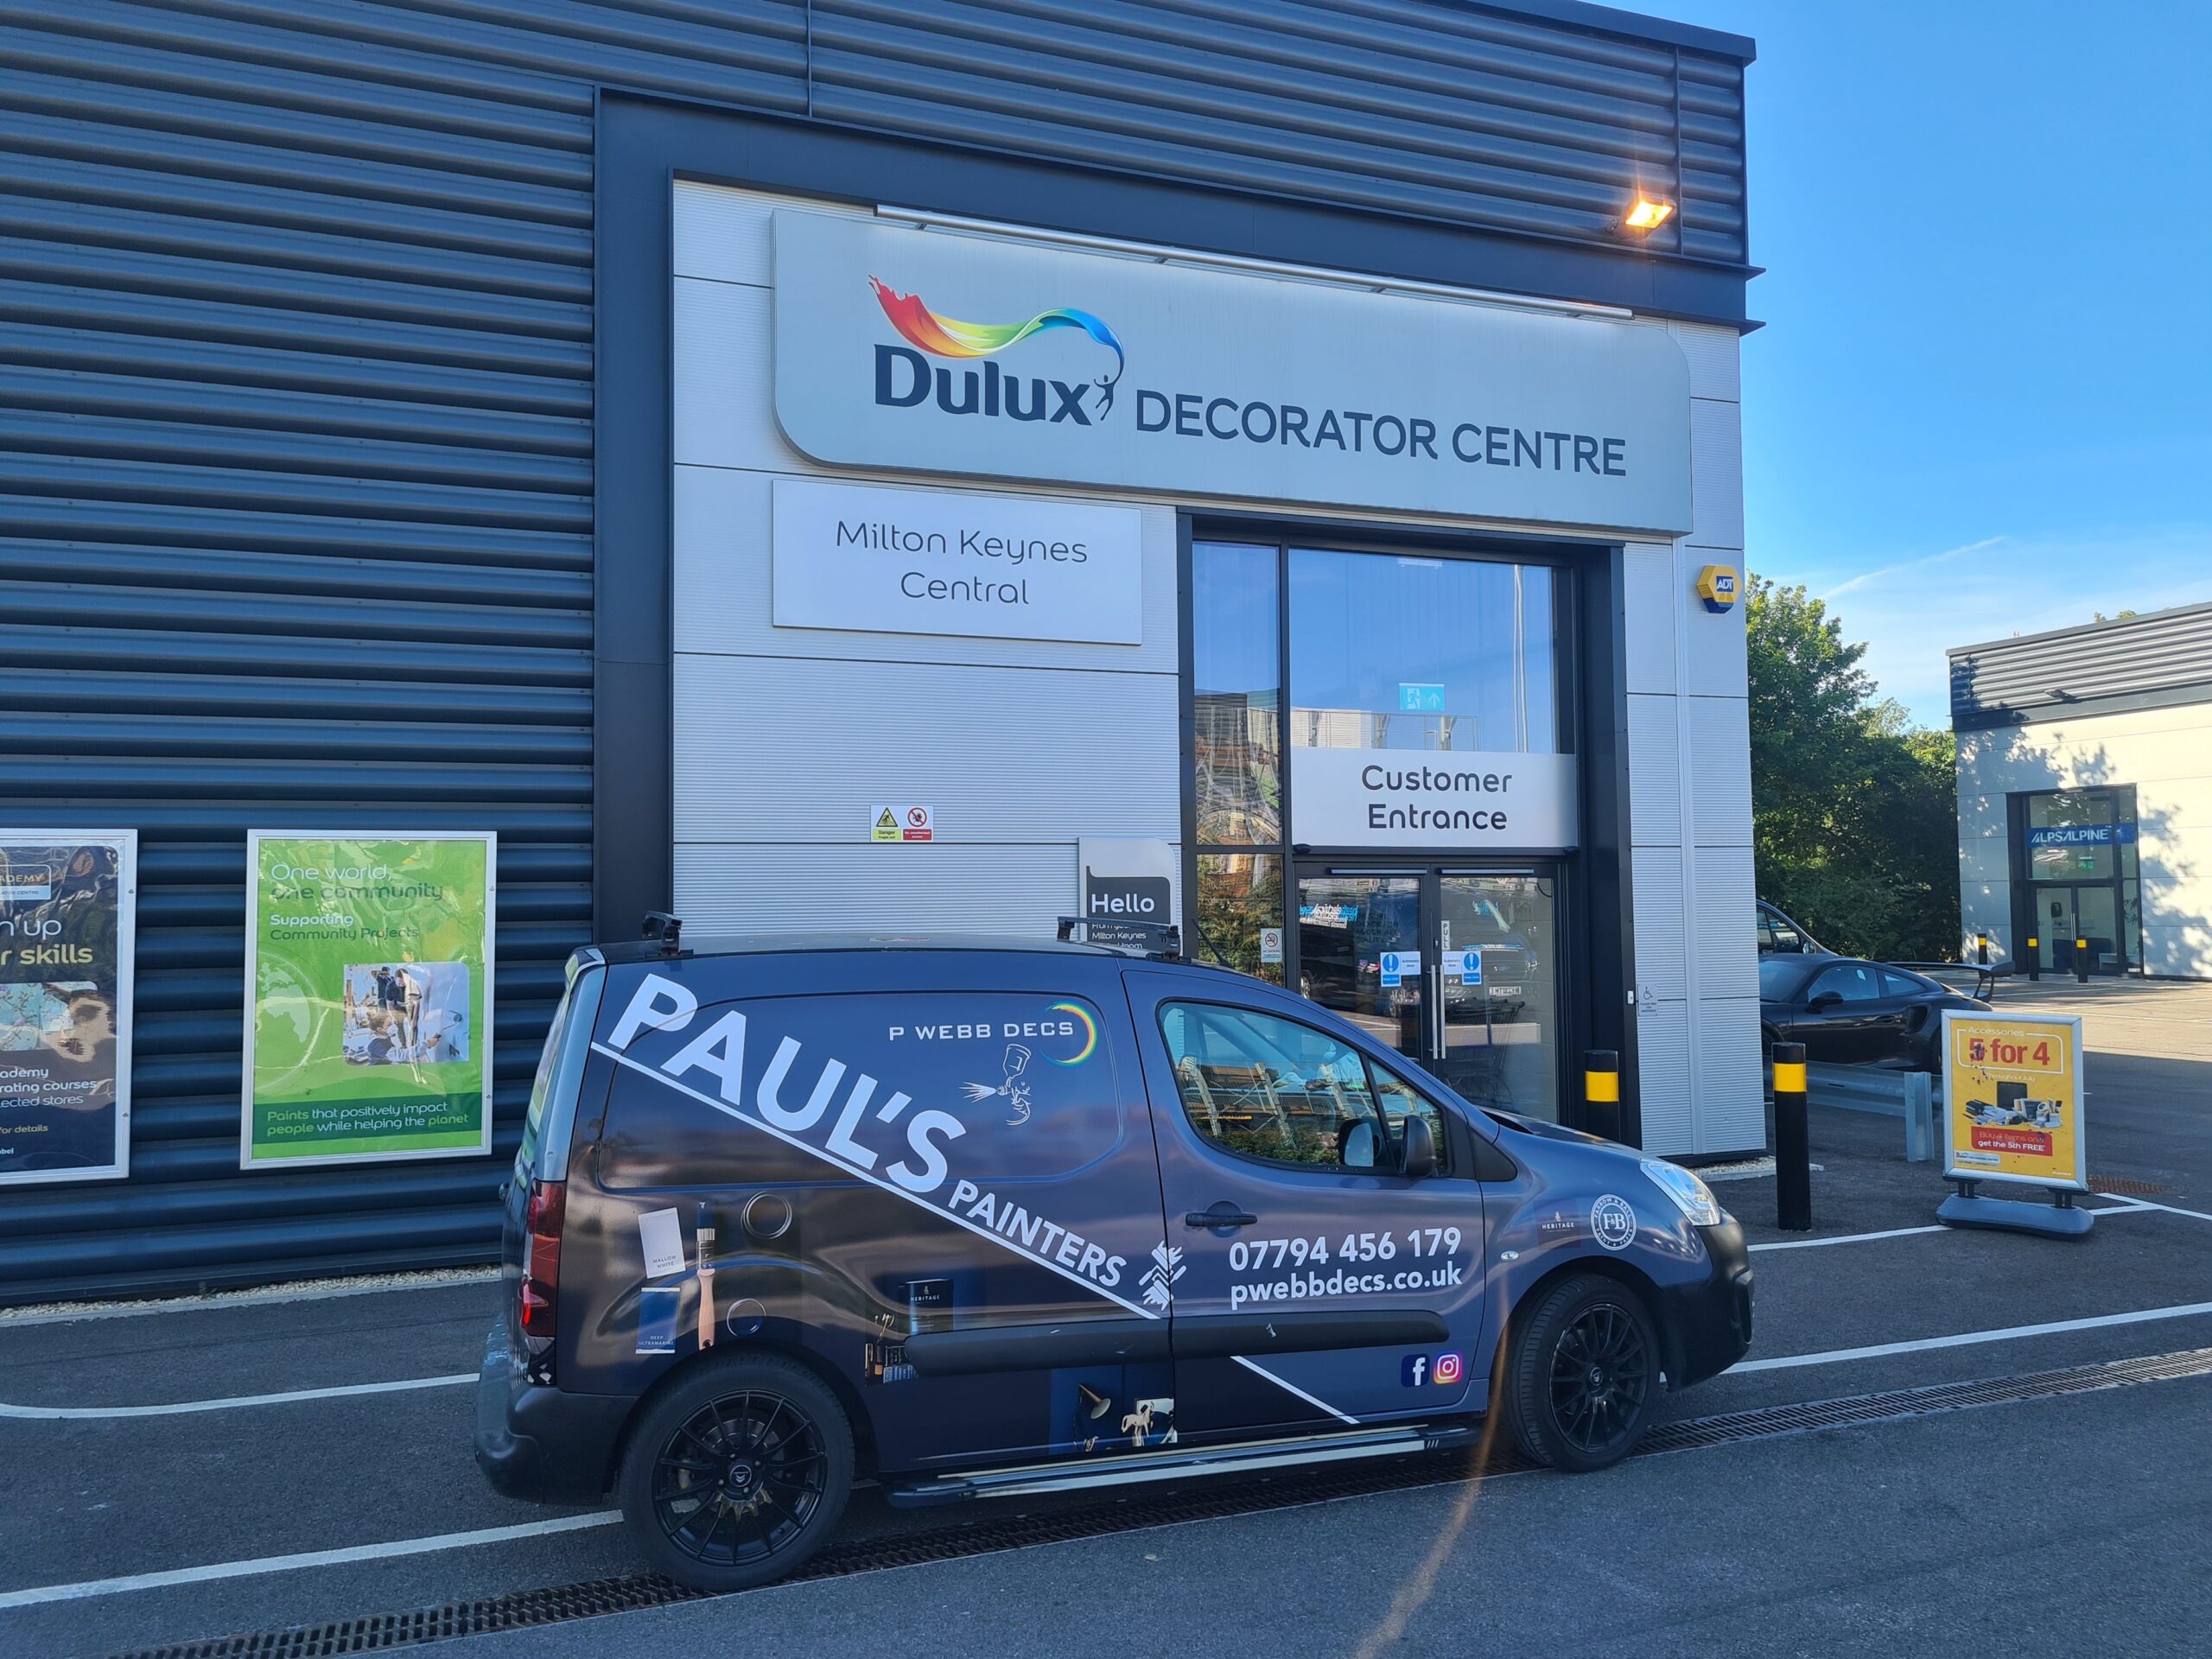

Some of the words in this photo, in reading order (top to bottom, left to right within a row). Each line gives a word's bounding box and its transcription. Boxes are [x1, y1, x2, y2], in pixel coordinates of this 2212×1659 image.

[873, 343, 1092, 426] Dulux
[1135, 389, 1439, 461] DECORATOR
[1451, 422, 1627, 478] CENTRE
[836, 519, 947, 554] Milton
[960, 529, 1088, 565] Keynes
[900, 571, 1030, 605] Central
[1716, 578, 1734, 590] ADT
[1361, 764, 1513, 793] Customer
[1368, 803, 1508, 830] Entrance
[2031, 829, 2109, 843] ALPSALPINE
[270, 863, 319, 880] One
[325, 863, 392, 882] world,
[270, 887, 315, 900] one
[321, 882, 444, 901] community
[1091, 893, 1155, 913] Hello
[270, 912, 354, 927] Supporting
[23, 919, 62, 941] up
[270, 927, 358, 941] Community
[360, 926, 420, 941] Projects
[1091, 931, 1116, 940] Milton
[1117, 931, 1147, 941] Keynes
[19, 943, 93, 965] skills
[889, 1026, 905, 1041] P
[914, 1023, 991, 1040] WEBB
[1003, 1020, 1074, 1038] DECS
[1967, 1027, 2024, 1037] Accessories
[1989, 1038, 2028, 1065] for
[2031, 1040, 2050, 1065] 4
[0, 1082, 40, 1094] rating
[42, 1080, 98, 1091] courses
[606, 972, 967, 1194] PAUL'S
[42, 1096, 84, 1106] stores
[266, 1109, 309, 1122] Paints
[311, 1108, 338, 1120] that
[340, 1104, 401, 1120] positively
[403, 1101, 448, 1115] impact
[14, 1124, 48, 1134] details
[266, 1124, 315, 1137] people
[316, 1121, 352, 1132] while
[353, 1118, 403, 1130] helping
[404, 1116, 426, 1127] the
[427, 1113, 469, 1127] planet
[1993, 1140, 2006, 1148] the
[1541, 1222, 1575, 1230] HERITAGE
[1602, 1212, 1626, 1230] F&B
[948, 1179, 1128, 1287] PAINTERS
[652, 1254, 677, 1264] MALLOW
[1229, 1236, 1330, 1272] 07794
[1338, 1231, 1397, 1262] 456
[1407, 1226, 1462, 1258] 179
[1230, 1260, 1463, 1311] pwebbdecs.co.uk
